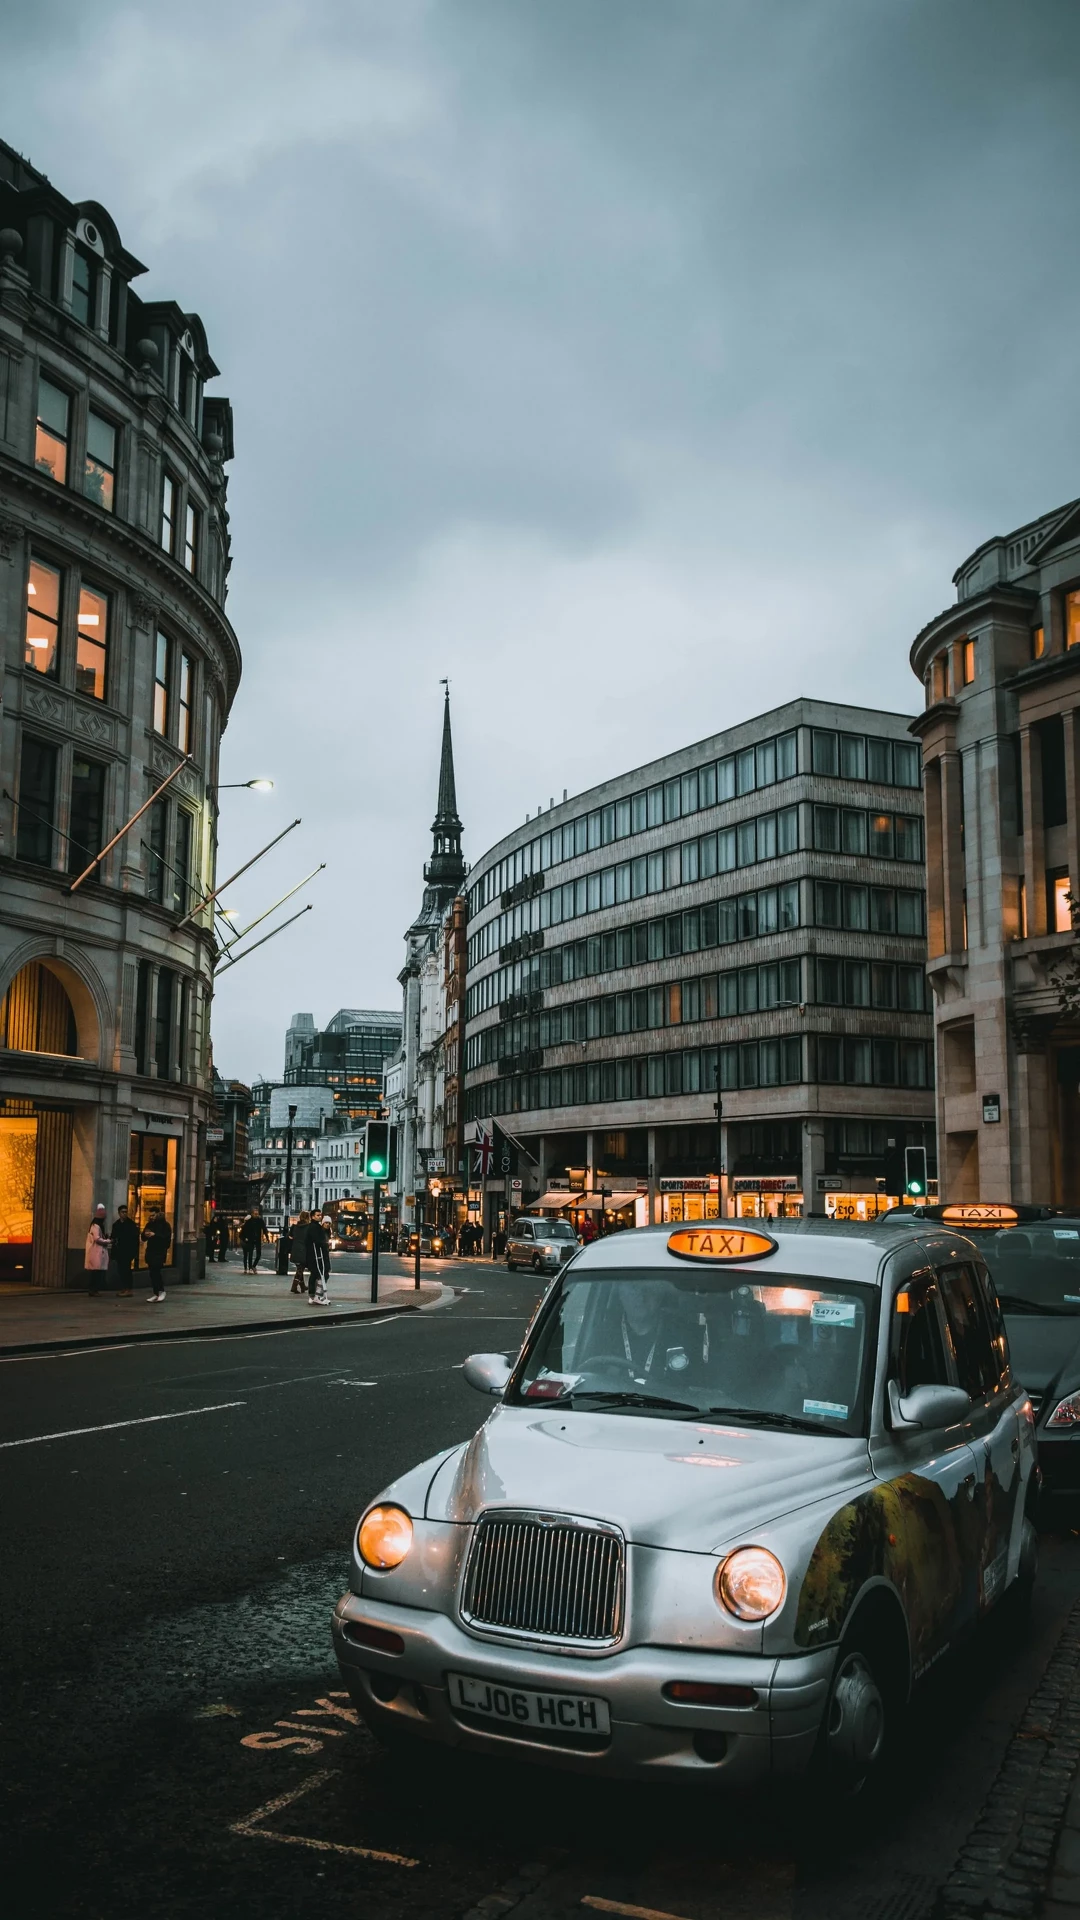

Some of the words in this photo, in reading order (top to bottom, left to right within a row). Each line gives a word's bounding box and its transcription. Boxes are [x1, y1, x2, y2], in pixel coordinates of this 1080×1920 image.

[707, 1207, 719, 1217] £10
[837, 1205, 855, 1215] £10
[958, 1208, 1002, 1217] TAXI
[687, 1234, 745, 1254] TAXI
[815, 1308, 841, 1316] 54776
[457, 1679, 530, 1721] LJ06
[536, 1696, 598, 1729] HCH
